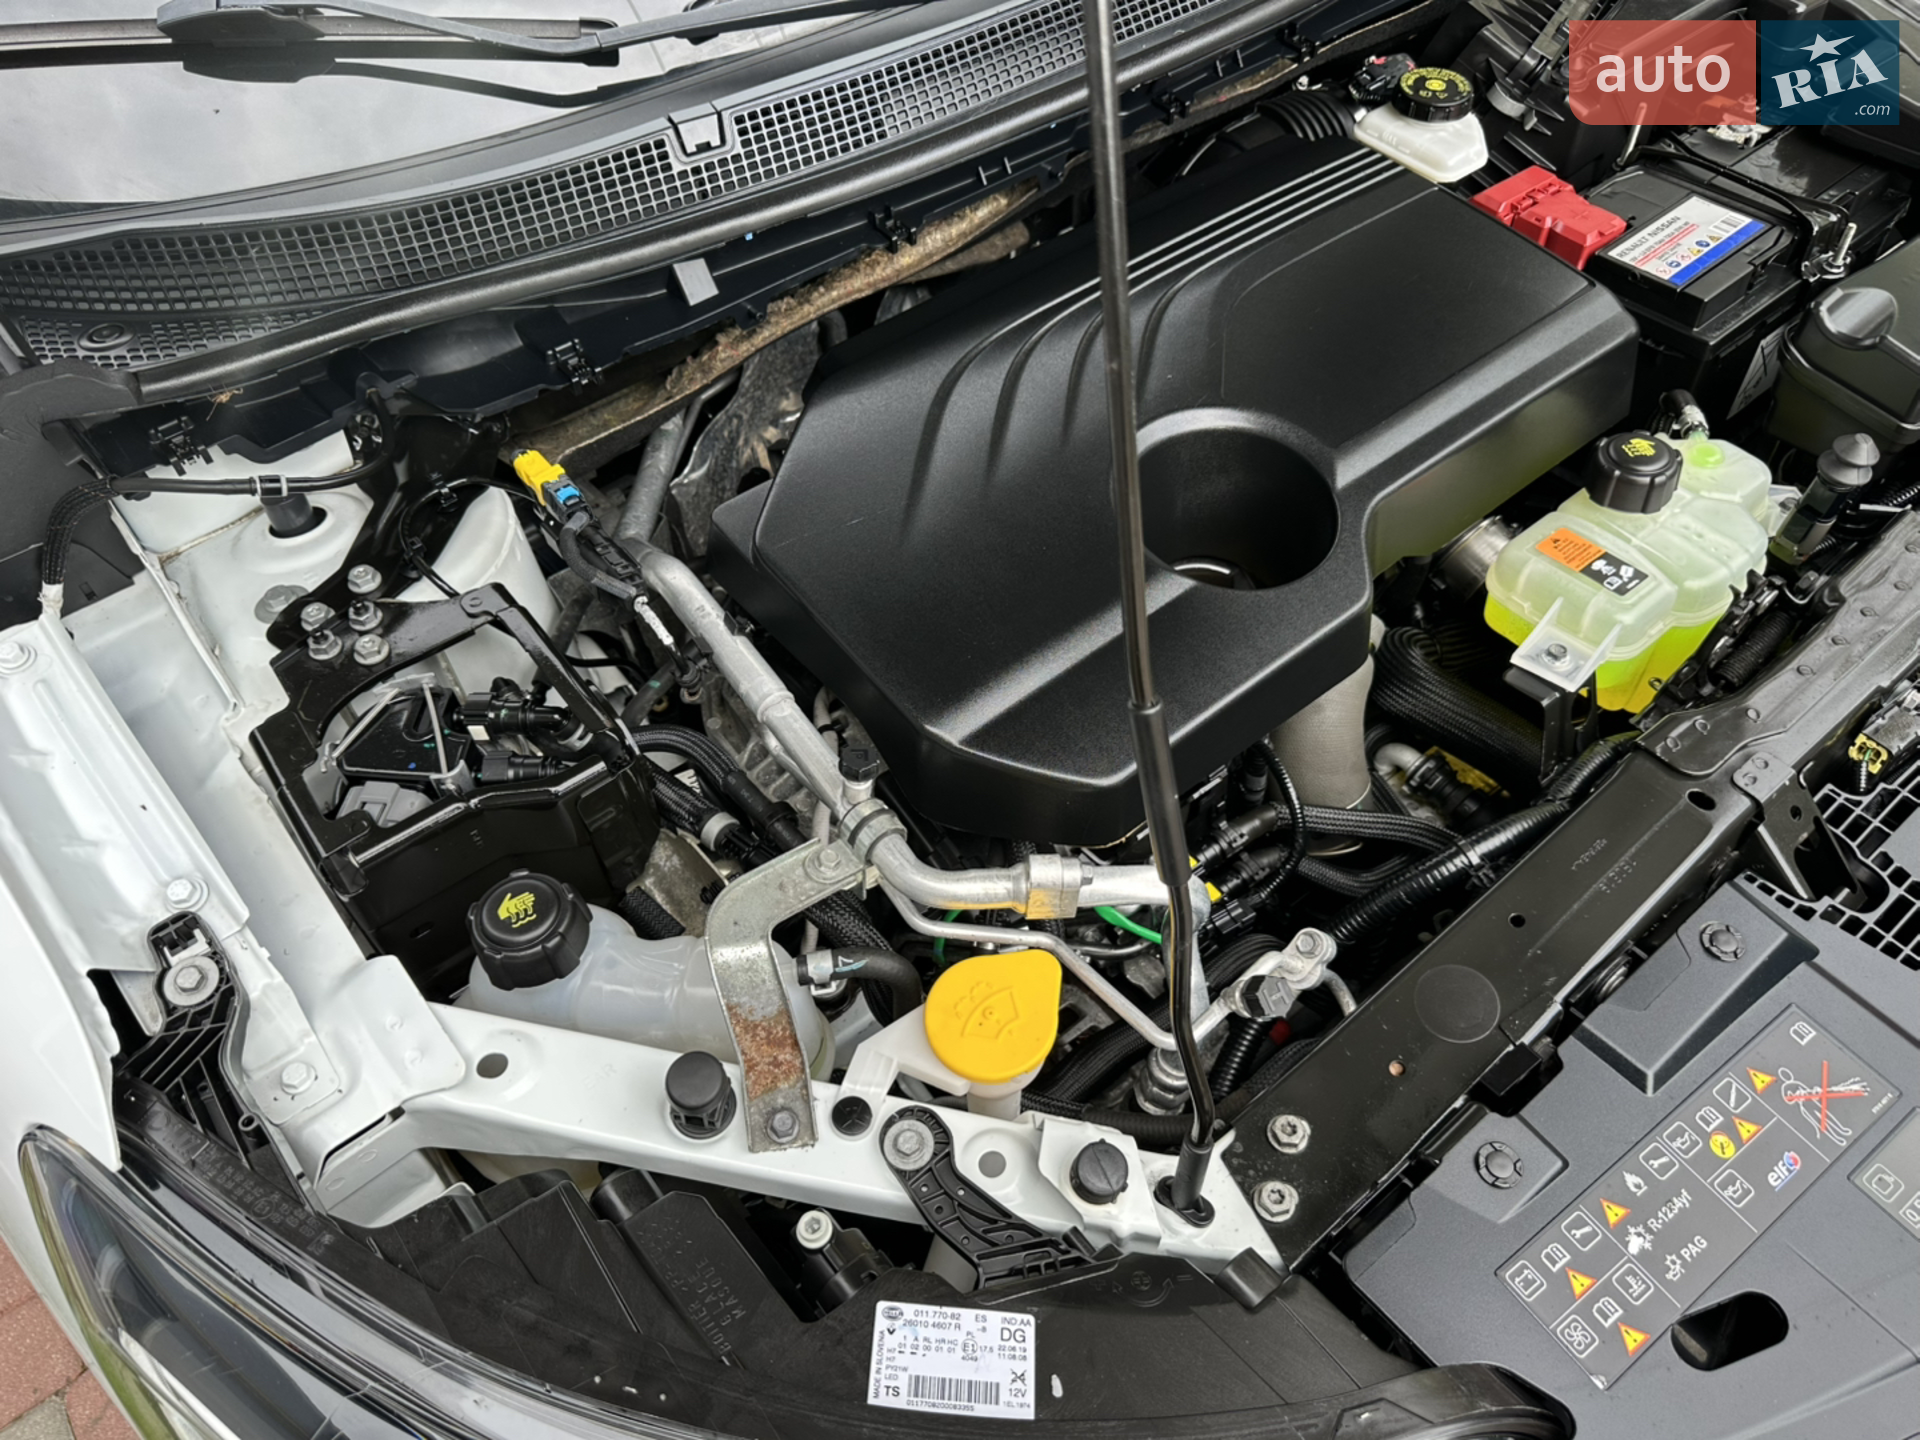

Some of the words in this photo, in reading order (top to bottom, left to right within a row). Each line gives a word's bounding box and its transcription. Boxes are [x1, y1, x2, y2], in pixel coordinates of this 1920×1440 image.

[1648, 215, 1682, 238] NISSAN
[1646, 1188, 1692, 1232] R-1234yf
[1680, 1235, 1708, 1262] PAG
[686, 1269, 733, 1326] GLACE
[694, 1256, 746, 1319] MASQUE
[686, 1299, 732, 1354] BOITIER
[902, 1318, 929, 1328] 26010
[930, 1320, 953, 1330] 4607
[954, 1322, 961, 1331] R
[975, 1314, 987, 1323] ES
[1000, 1327, 1027, 1344] DG
[875, 1367, 882, 1375] IN
[873, 1378, 882, 1399] MADE
[883, 1385, 901, 1397] TS
[1008, 1388, 1027, 1398] 12V
